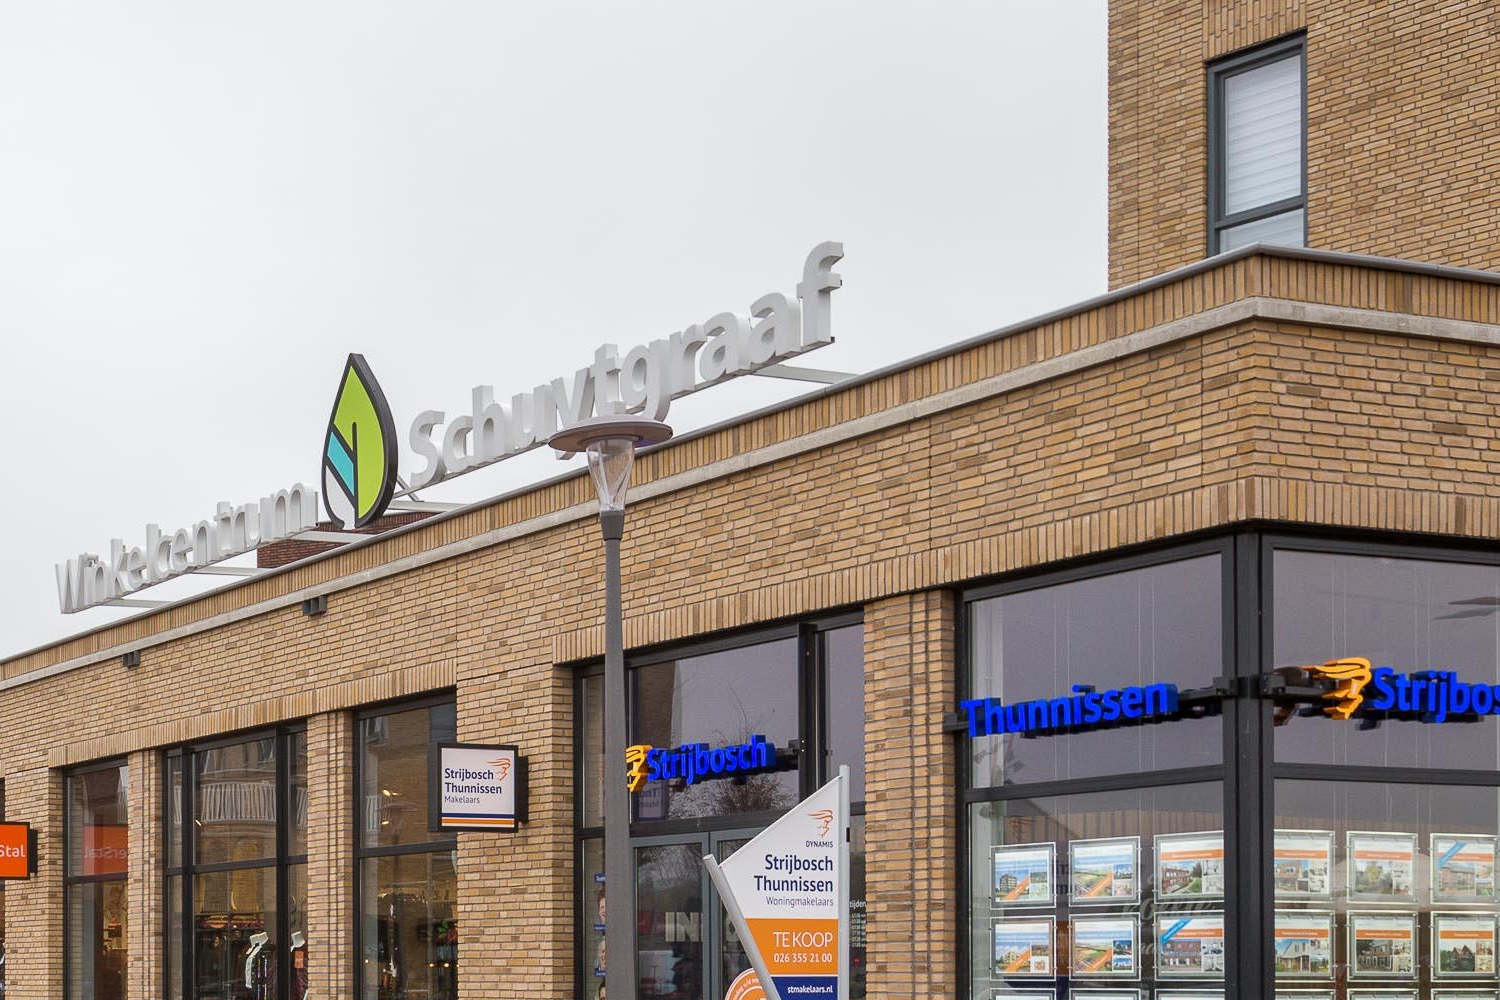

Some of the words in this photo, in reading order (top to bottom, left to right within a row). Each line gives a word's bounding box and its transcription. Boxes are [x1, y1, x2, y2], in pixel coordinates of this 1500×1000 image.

[55, 482, 318, 614] Winkelcentrum
[409, 240, 844, 487] Schuytgraaf
[961, 683, 1171, 739] Thunnissen
[647, 735, 771, 785] Strijbosch
[444, 768, 494, 781] Strijbosch
[444, 782, 502, 794] Thunnissen
[444, 795, 480, 804] Makelaars
[805, 840, 834, 848] DYNAMIS
[765, 854, 834, 874] Strijbosch
[753, 875, 834, 892] Thunnissen
[766, 895, 834, 908] Woningmakelaars
[773, 931, 790, 947] TE
[792, 931, 834, 947] KOOP
[773, 953, 790, 962] 026
[792, 953, 807, 962] 355
[809, 953, 819, 962] 21
[821, 953, 833, 962] 00
[787, 985, 834, 994] stmakelaars.nl
